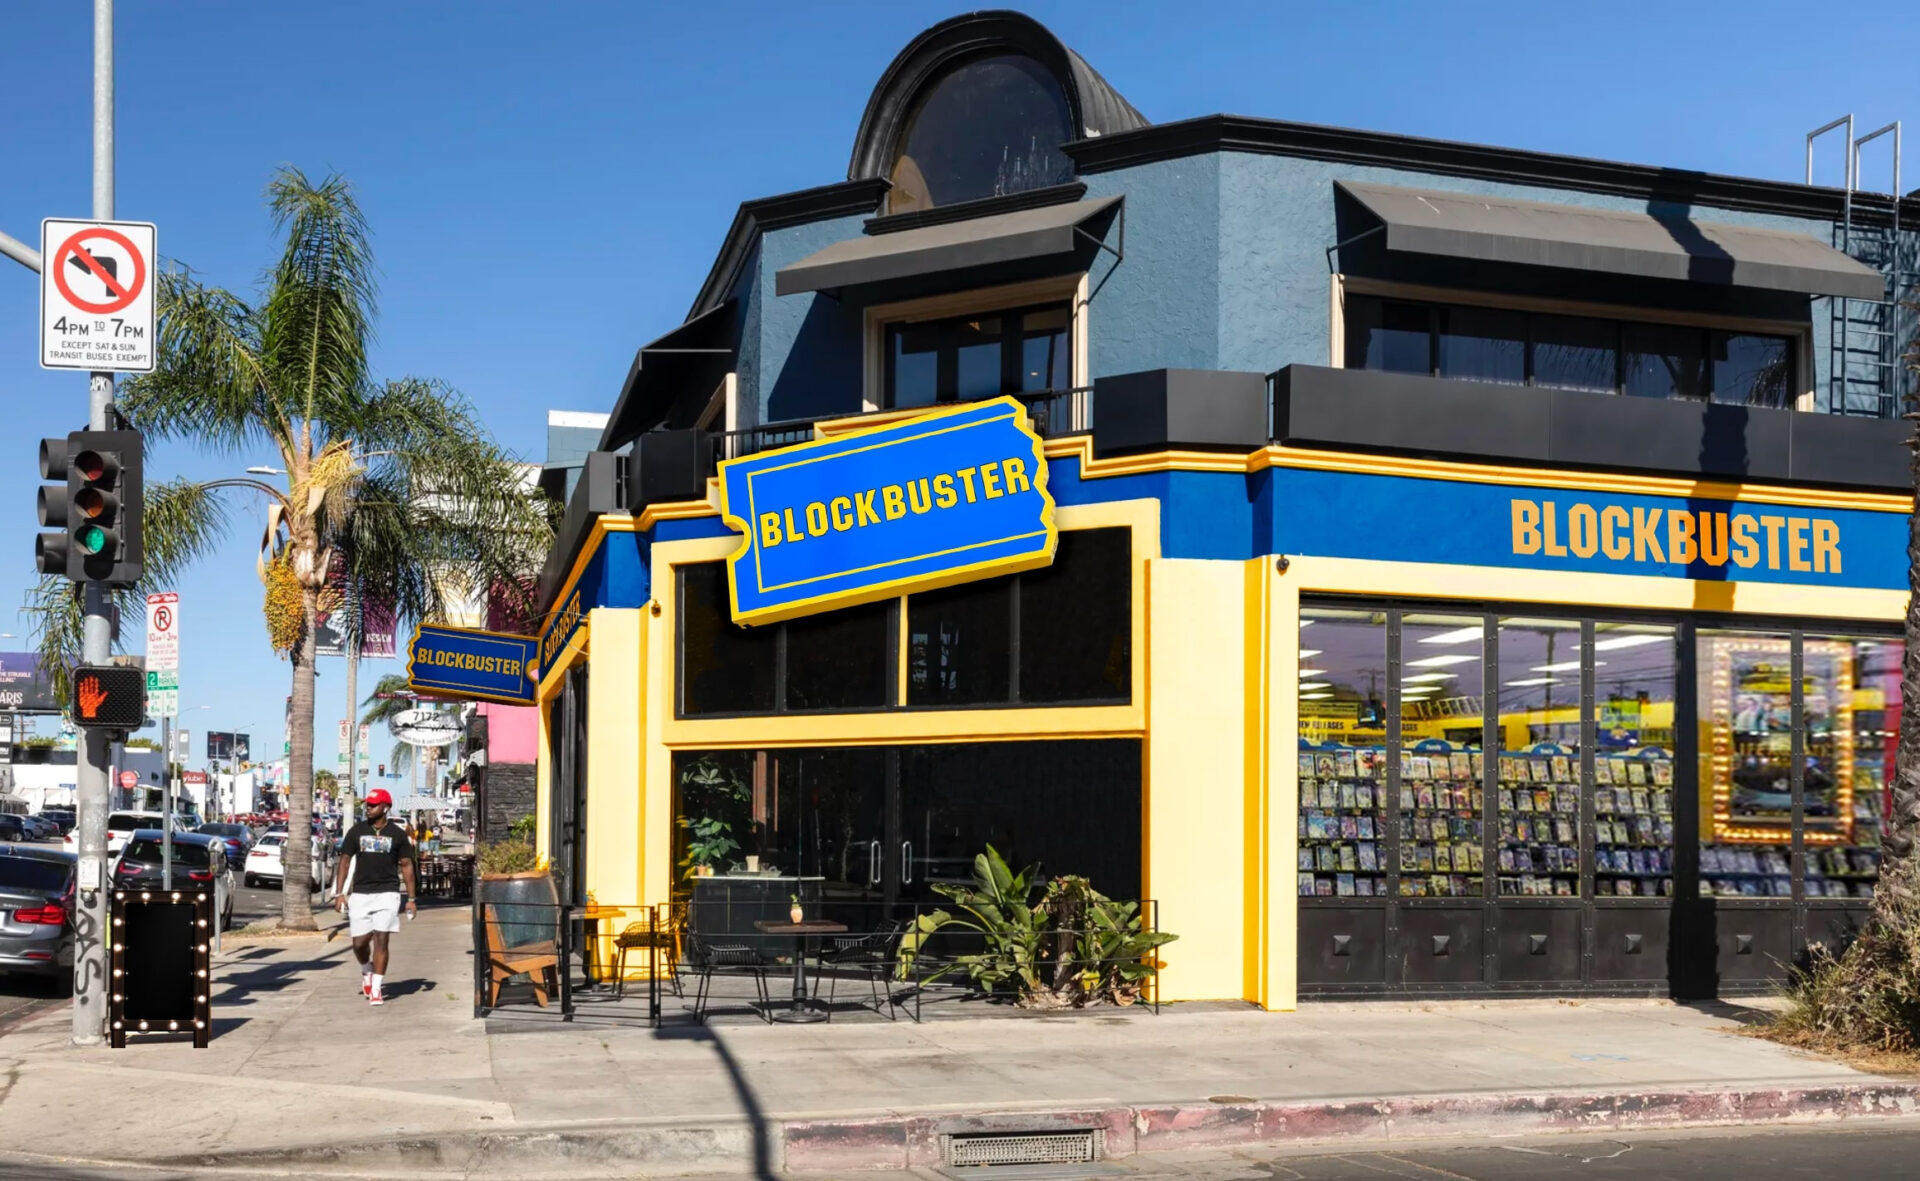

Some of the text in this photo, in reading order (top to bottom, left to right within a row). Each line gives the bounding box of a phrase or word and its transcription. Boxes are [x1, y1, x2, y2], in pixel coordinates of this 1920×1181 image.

[53, 316, 144, 338] 4PM TO 7PM
[49, 351, 147, 362] TRANSIT BUSES EXEMPT
[61, 341, 92, 349] EXCEPT
[111, 343, 118, 351] &
[759, 457, 1030, 549] BLOCKBUSTER
[1511, 499, 1842, 574] BLOCKBUSTER
[417, 647, 521, 676] BLOCKBUSTER
